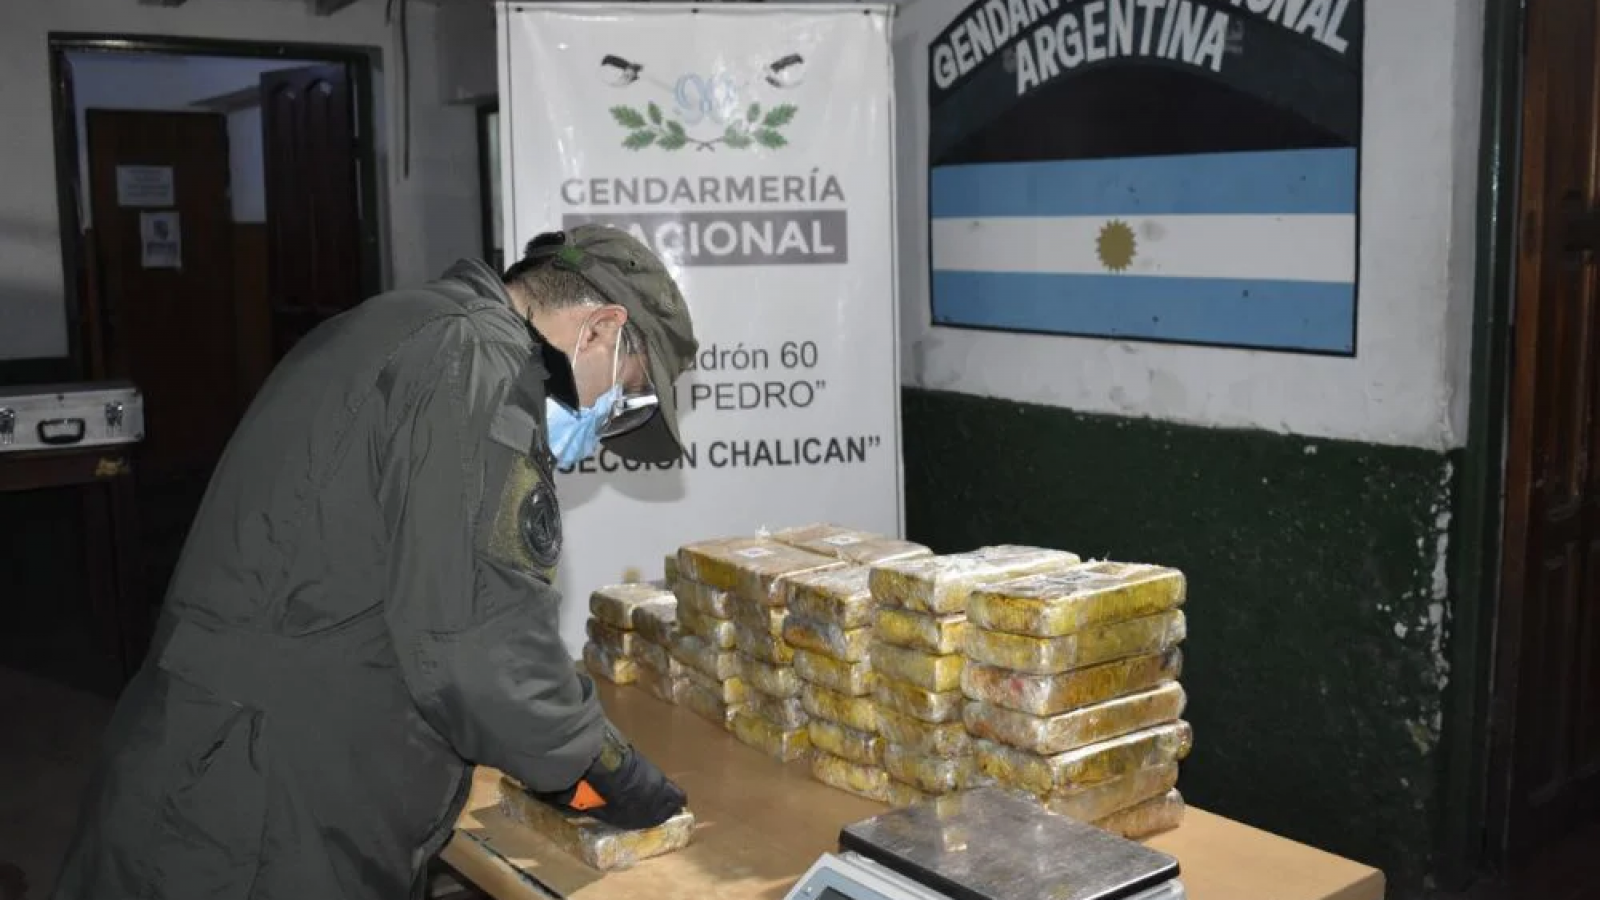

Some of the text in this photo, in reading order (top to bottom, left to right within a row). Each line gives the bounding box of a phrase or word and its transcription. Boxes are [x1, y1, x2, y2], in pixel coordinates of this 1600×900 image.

[1015, 0, 1229, 95] ARGENTINA
[561, 167, 845, 206] GENDARMERÍA
[780, 340, 818, 369] 60
